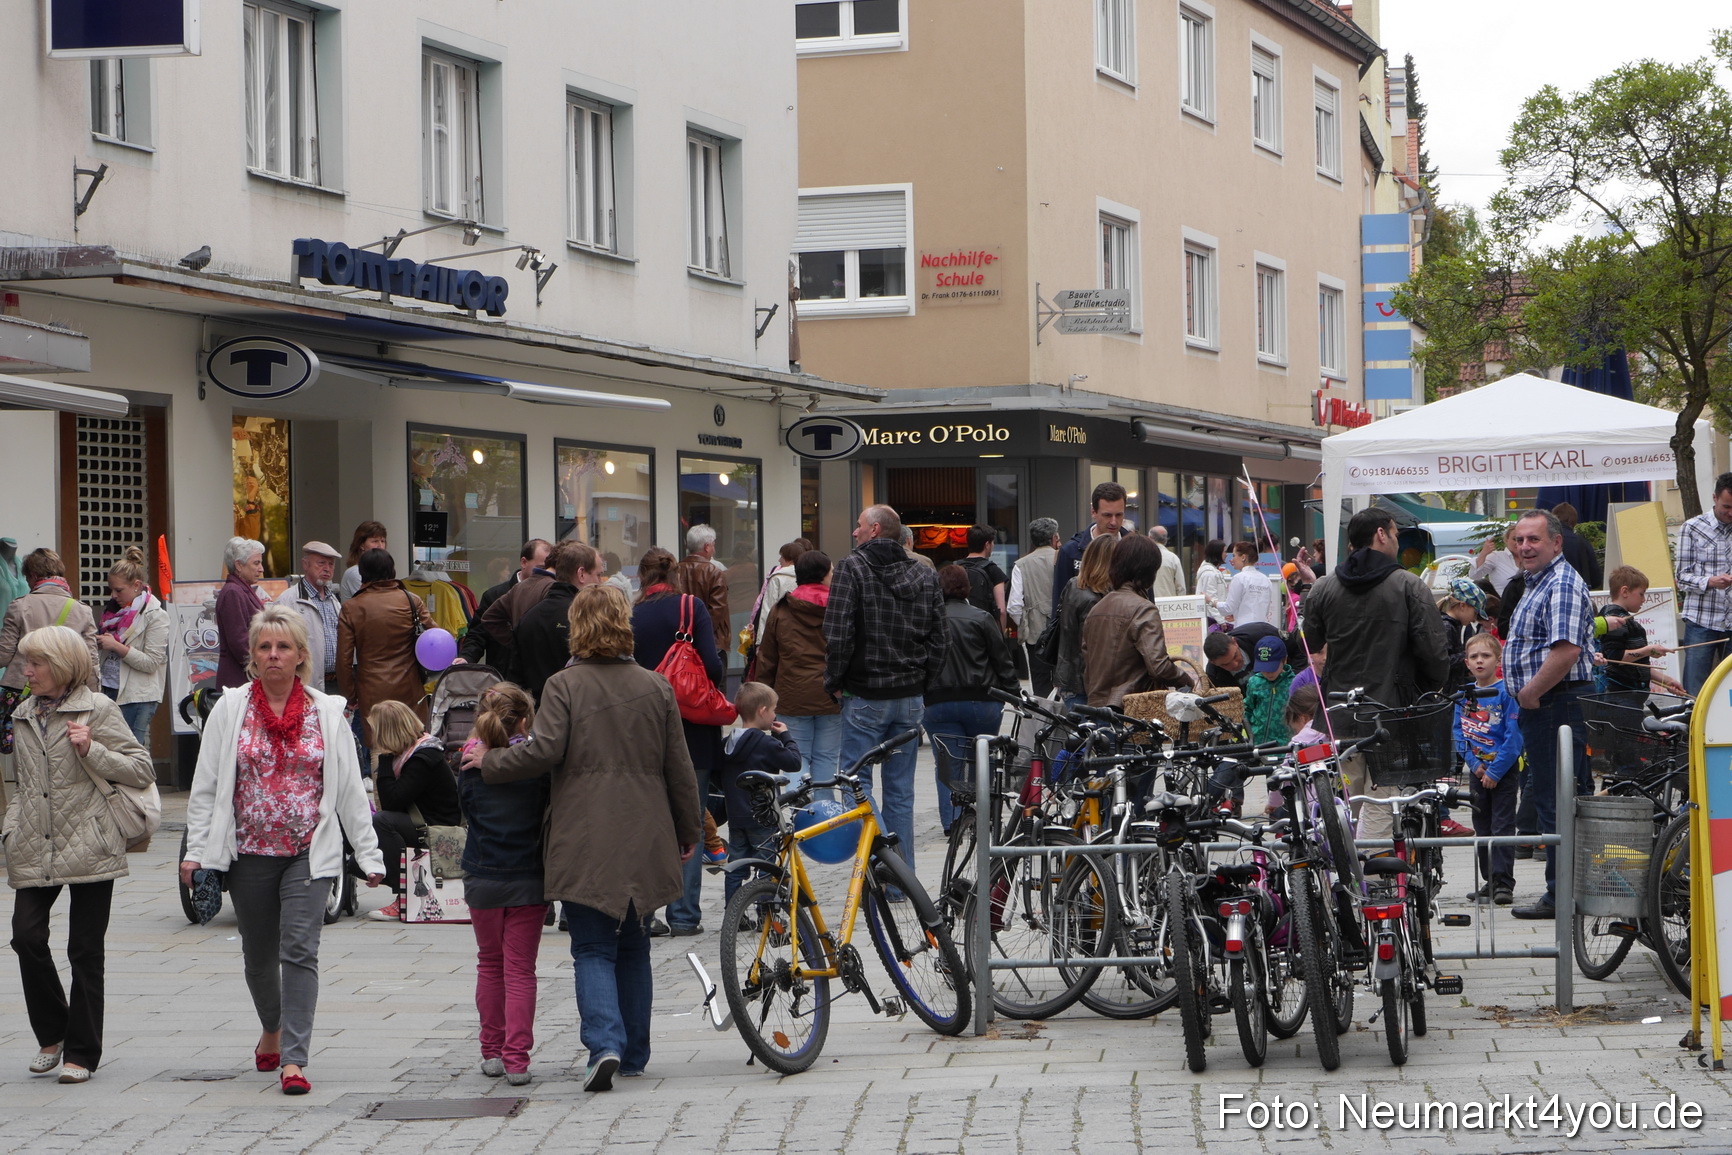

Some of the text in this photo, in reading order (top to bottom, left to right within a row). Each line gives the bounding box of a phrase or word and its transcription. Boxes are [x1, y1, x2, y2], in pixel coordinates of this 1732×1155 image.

[921, 251, 999, 268] Nachhilfe-
[294, 238, 509, 317] TOM TAILOR
[936, 271, 985, 287] Schule
[1067, 290, 1100, 299] Bauer's
[1073, 298, 1126, 308] Brillenstudio
[861, 424, 1010, 446] Marc O'Polo
[1049, 424, 1067, 443] Marc
[1362, 466, 1429, 477] 09181/466355
[1438, 449, 1593, 474] BRIGITTEKARL
